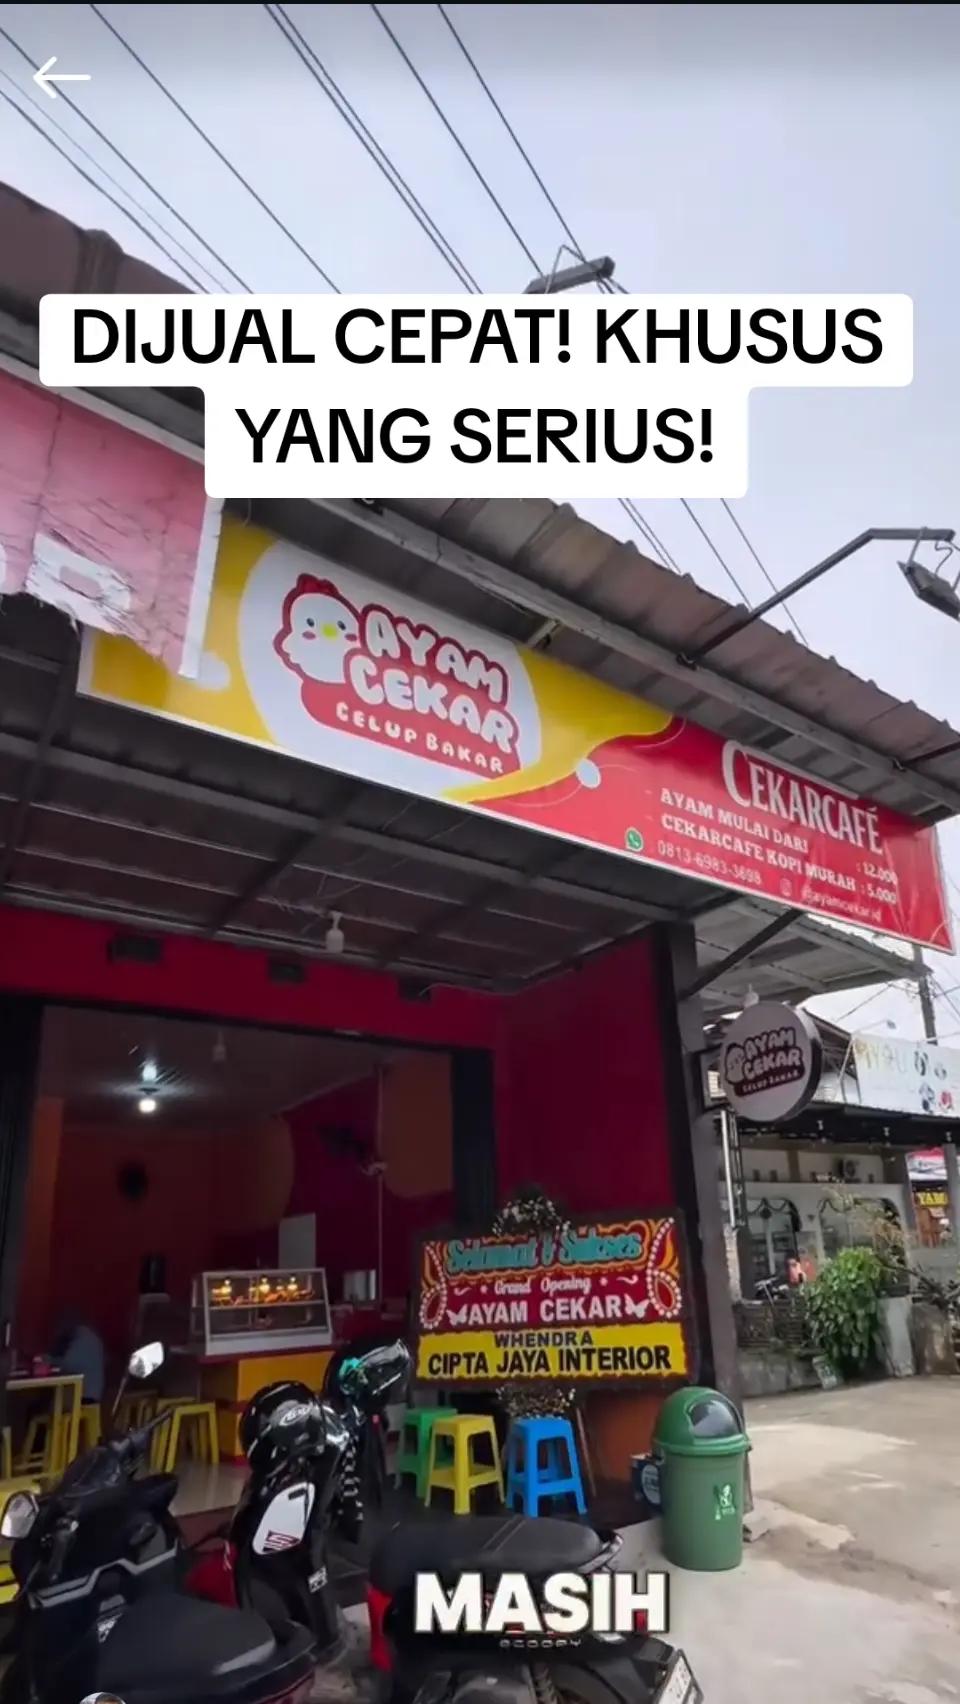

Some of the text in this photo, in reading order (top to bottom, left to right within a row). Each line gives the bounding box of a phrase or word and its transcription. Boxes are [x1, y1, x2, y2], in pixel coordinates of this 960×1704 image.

[365, 610, 504, 704] AYAM
[349, 654, 515, 754] CEKAR
[335, 702, 504, 774] CELUP BAKAR
[660, 787, 715, 820] AYAM
[717, 809, 769, 841] MULAI
[772, 828, 809, 854] DARI
[661, 813, 764, 862] CEKARCAFE
[766, 847, 803, 875] KOPI
[804, 864, 857, 892] MURAH
[744, 1027, 796, 1060] AYAM
[743, 1047, 802, 1081] CEKAR
[494, 1276, 592, 1297] Grand Opening
[468, 1294, 623, 1326] AYAM CEKAR
[494, 1331, 593, 1348] WHENDRA
[428, 1345, 672, 1376] CIPTA JAYA INTERIOR
